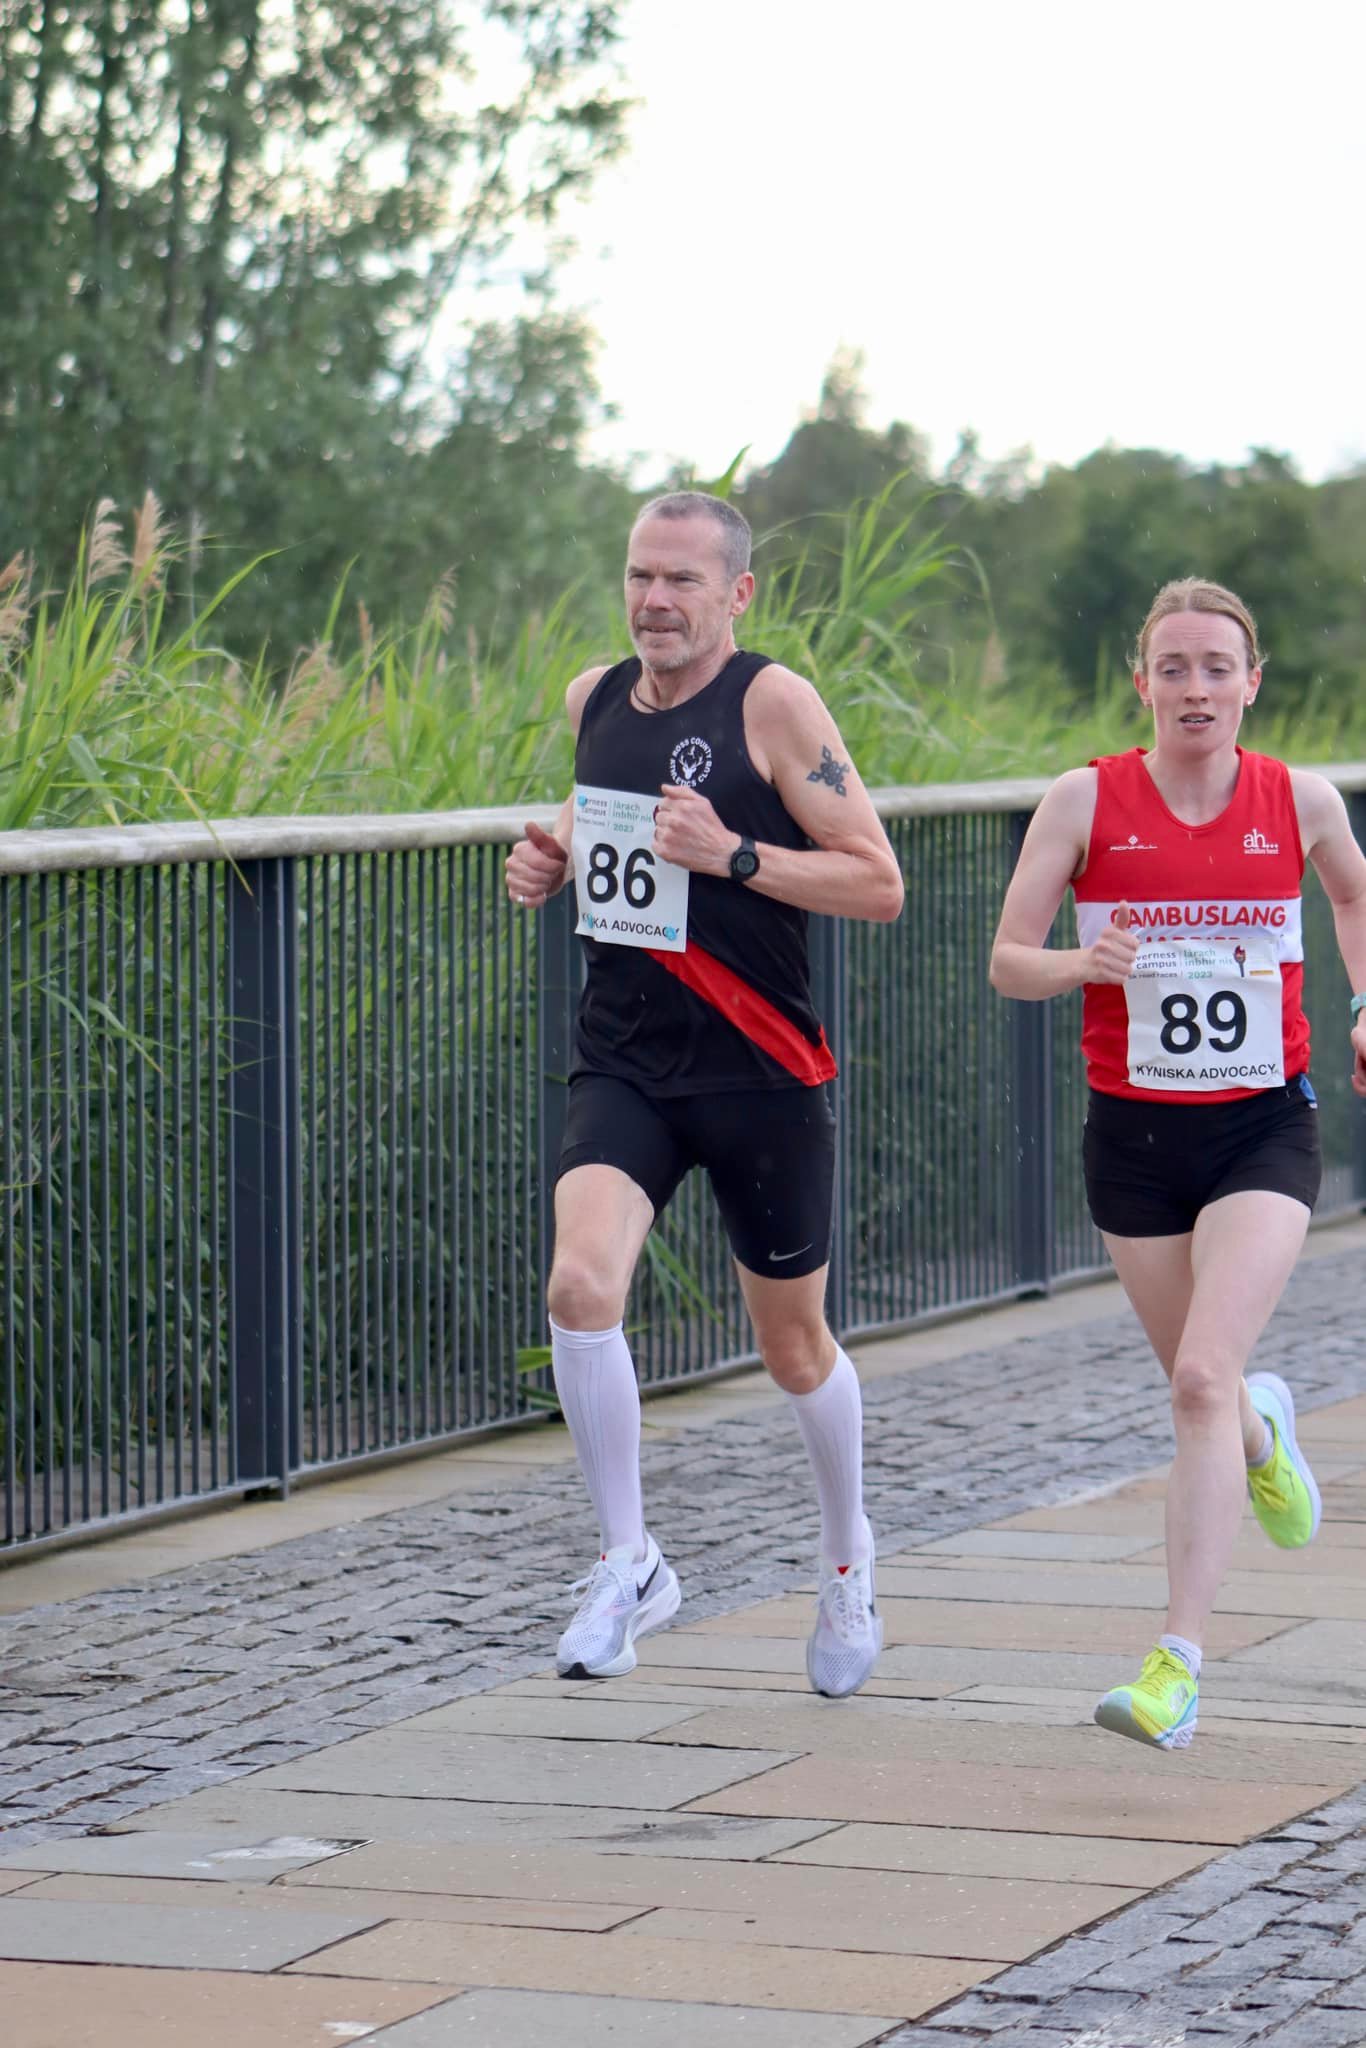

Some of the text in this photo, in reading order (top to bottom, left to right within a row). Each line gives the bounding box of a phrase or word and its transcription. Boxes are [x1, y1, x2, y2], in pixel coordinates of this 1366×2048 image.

[672, 737, 712, 758] ROSS COUNTY
[698, 760, 713, 783] CLUB
[587, 843, 656, 909] 86
[1135, 951, 1177, 962] verness
[1136, 960, 1177, 970] campus
[1160, 990, 1247, 1055] 89
[1136, 1063, 1277, 1080] KYNISKA ADVOCACY
